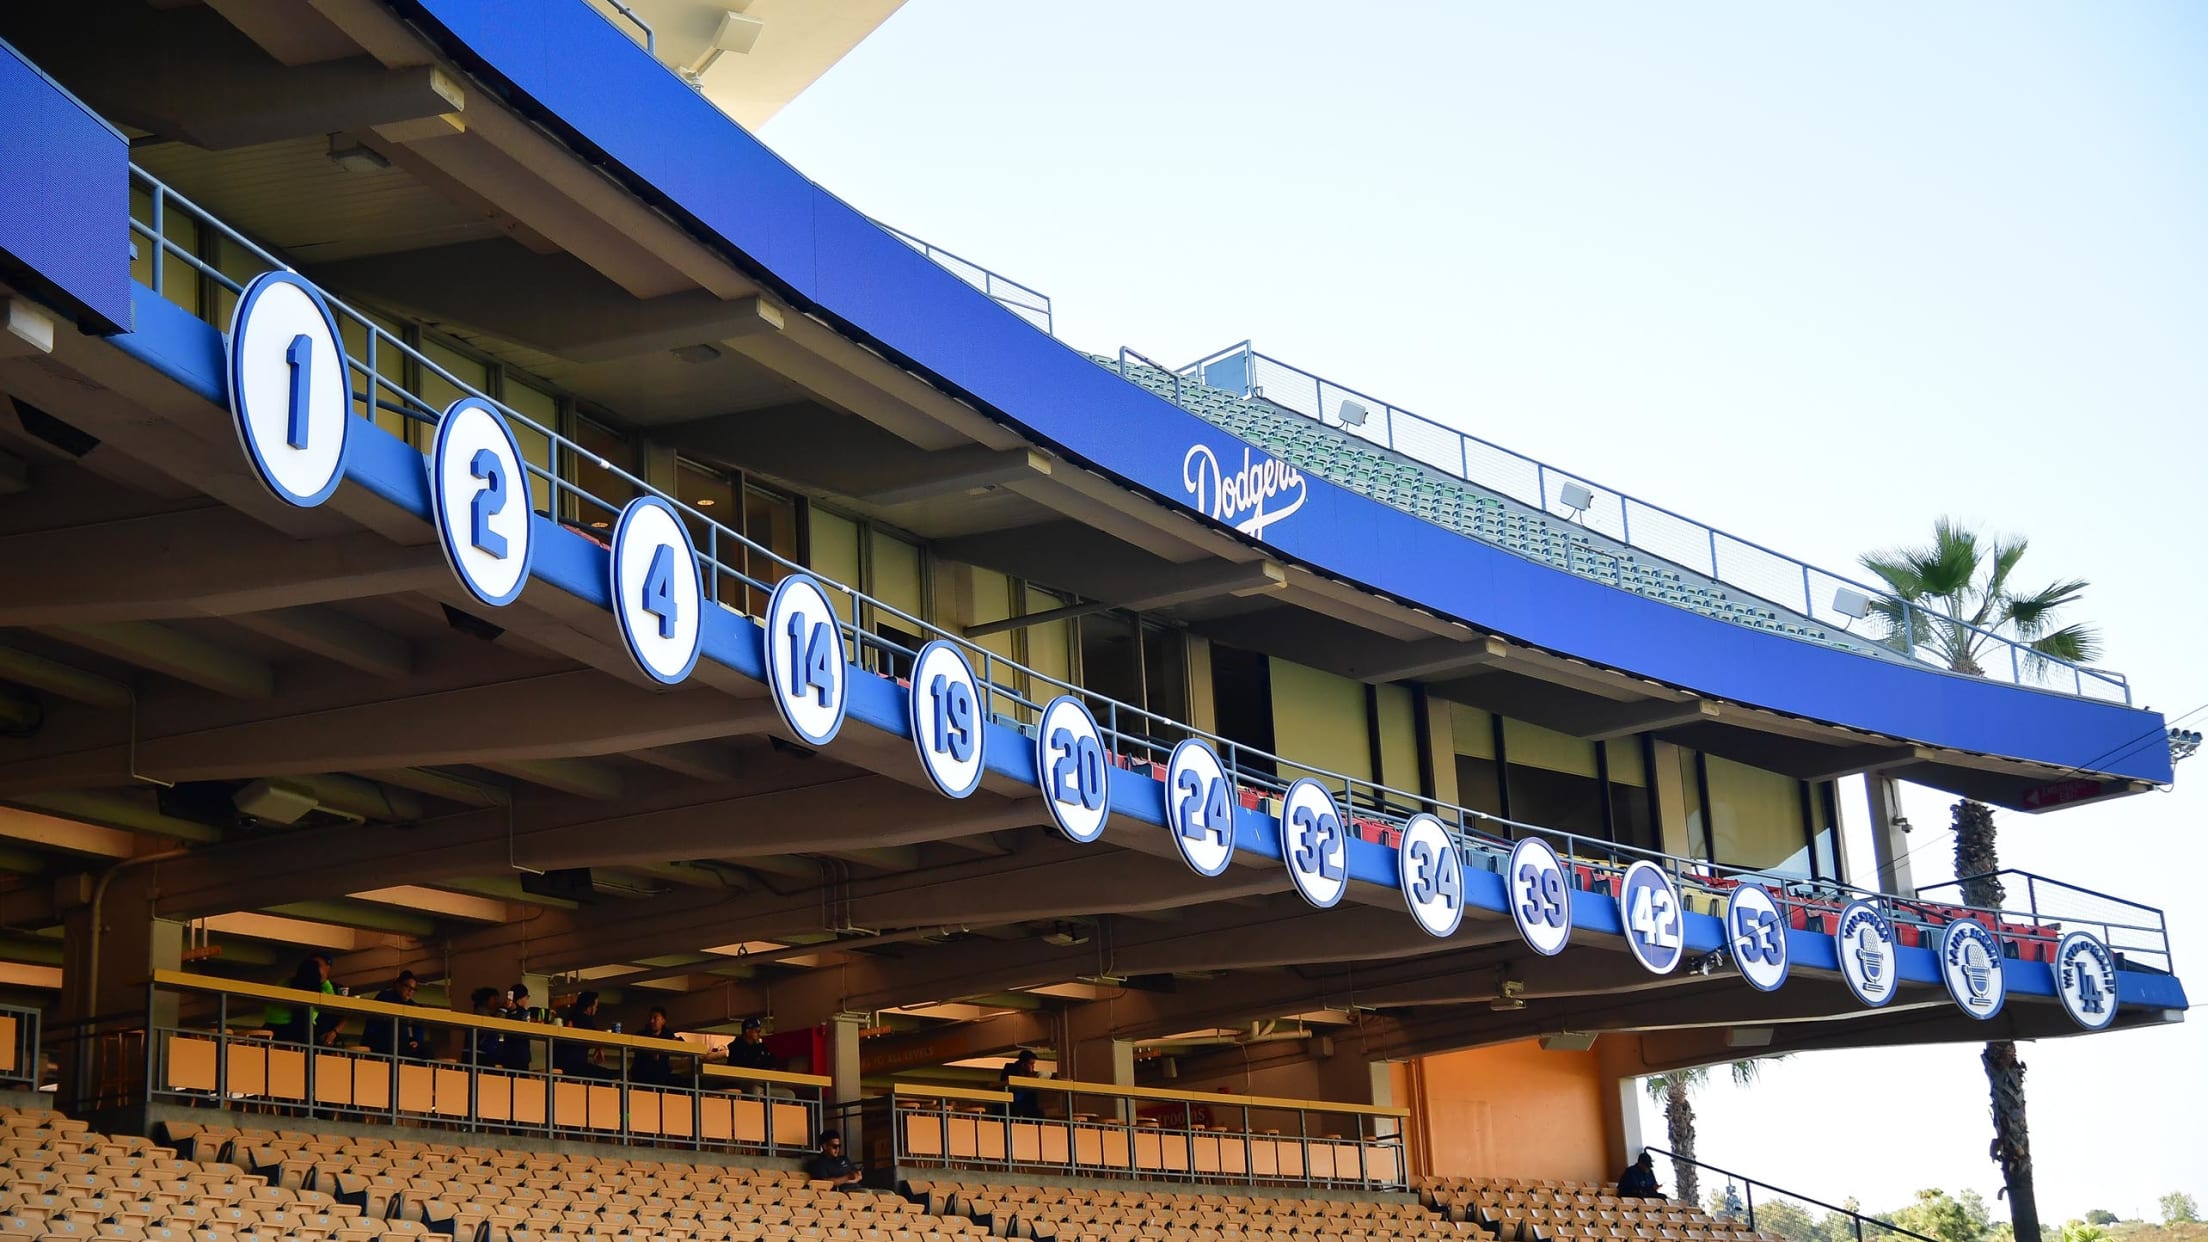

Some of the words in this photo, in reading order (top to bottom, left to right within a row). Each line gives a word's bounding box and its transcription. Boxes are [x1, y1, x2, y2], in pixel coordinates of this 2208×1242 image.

[285, 333, 313, 450] 1
[470, 448, 508, 560] 2
[1183, 443, 1307, 541] Dodgers
[642, 543, 678, 640] 4
[787, 611, 835, 709] 14
[930, 673, 974, 763] 19
[1051, 727, 1105, 811] 20
[1178, 768, 1231, 847] 24
[1292, 805, 1344, 882] 32
[1410, 840, 1459, 910] 34
[1519, 863, 1568, 928] 39
[1630, 885, 1679, 950] 42
[1735, 906, 1785, 966] 53
[2074, 961, 2106, 1014] LA
